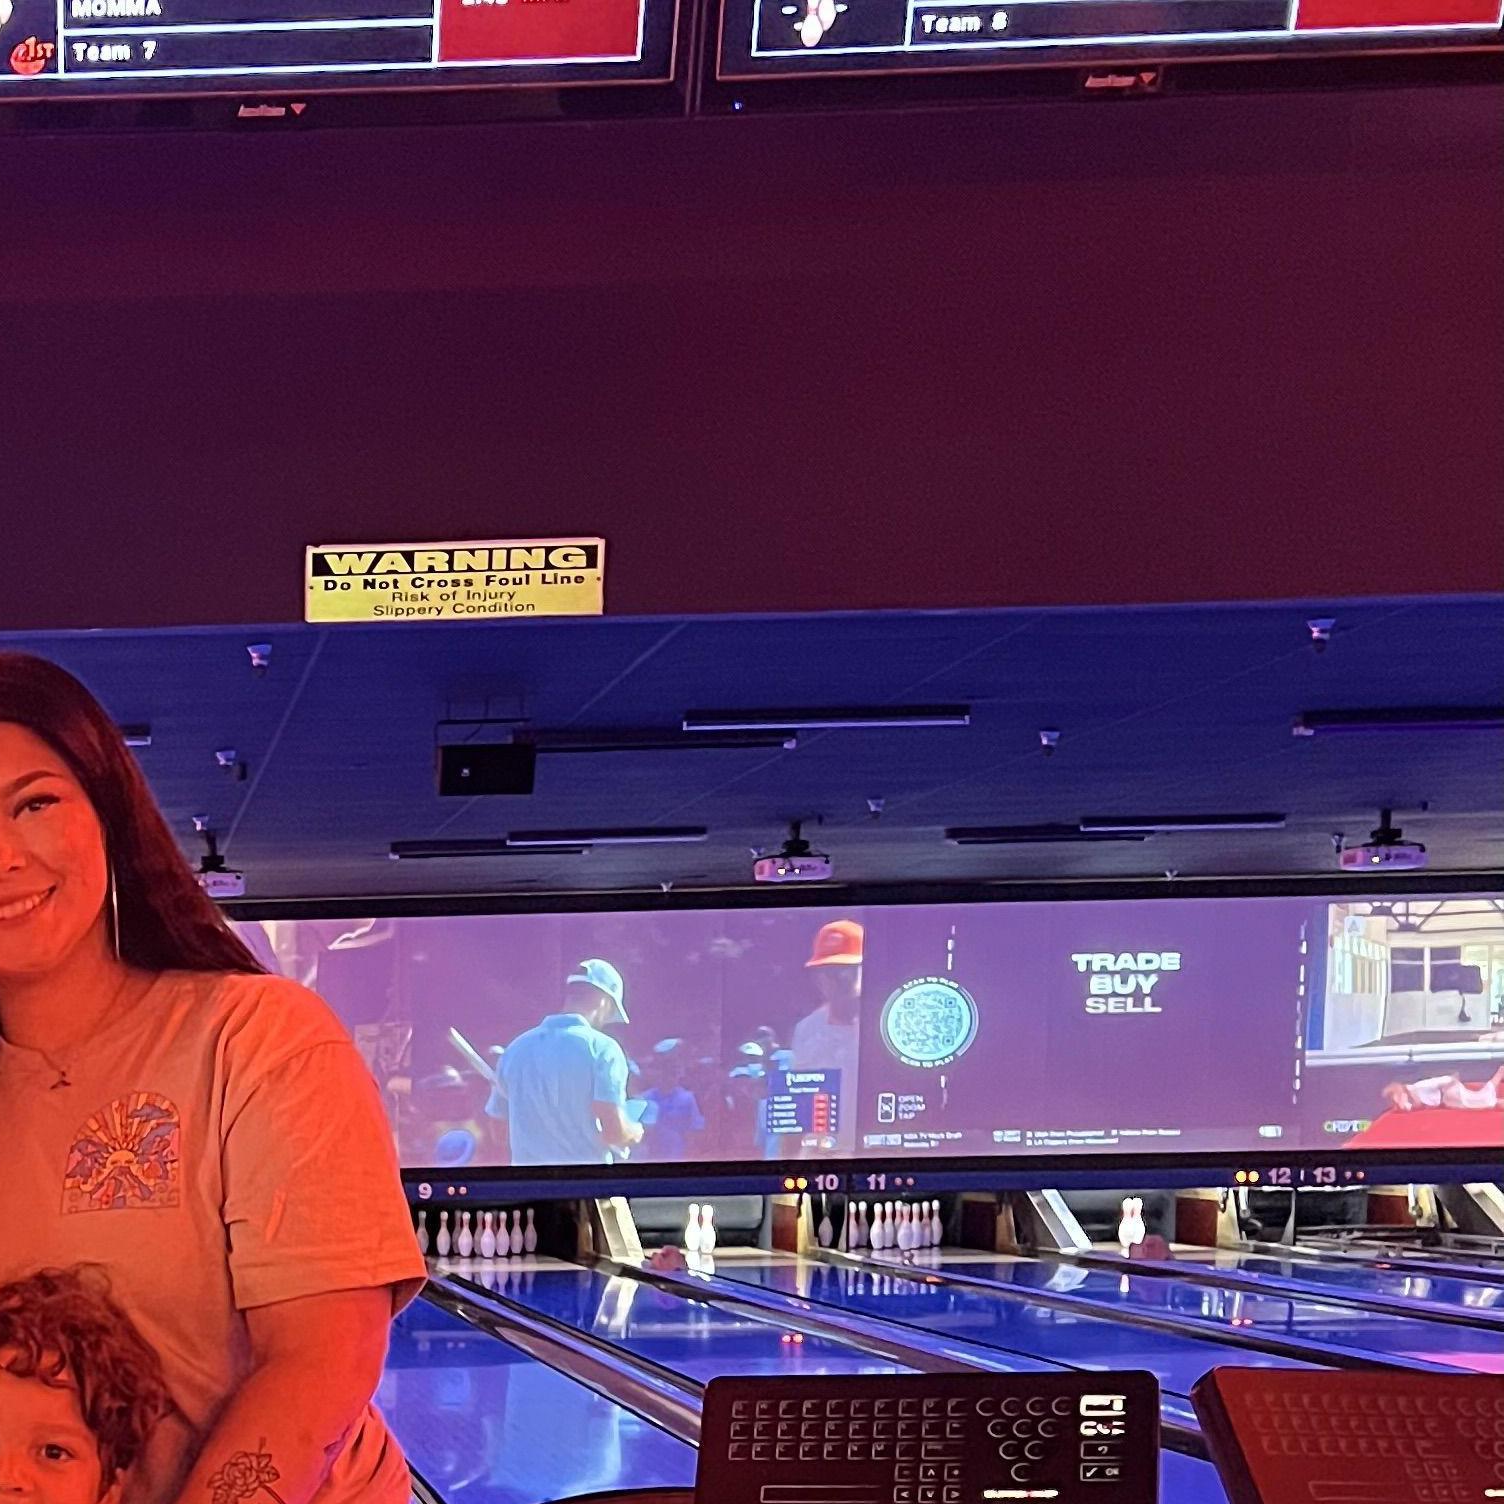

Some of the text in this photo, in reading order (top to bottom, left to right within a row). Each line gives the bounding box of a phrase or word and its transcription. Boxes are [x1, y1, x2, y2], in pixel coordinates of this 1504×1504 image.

[921, 14, 981, 34] Team
[73, 40, 159, 62] Team 7
[323, 546, 587, 575] WARNING
[323, 573, 585, 591] Do Not Cross Foul Line
[392, 589, 517, 603] Risk of Injury
[373, 602, 536, 617] Slippery Condition
[1071, 952, 1182, 973] TRADE
[1089, 974, 1159, 995] BUY
[1085, 996, 1163, 1014] SELL
[815, 1173, 839, 1191] 10
[866, 1173, 886, 1191] 11
[1268, 1166, 1336, 1184] 12 13
[418, 1182, 433, 1200] 9
